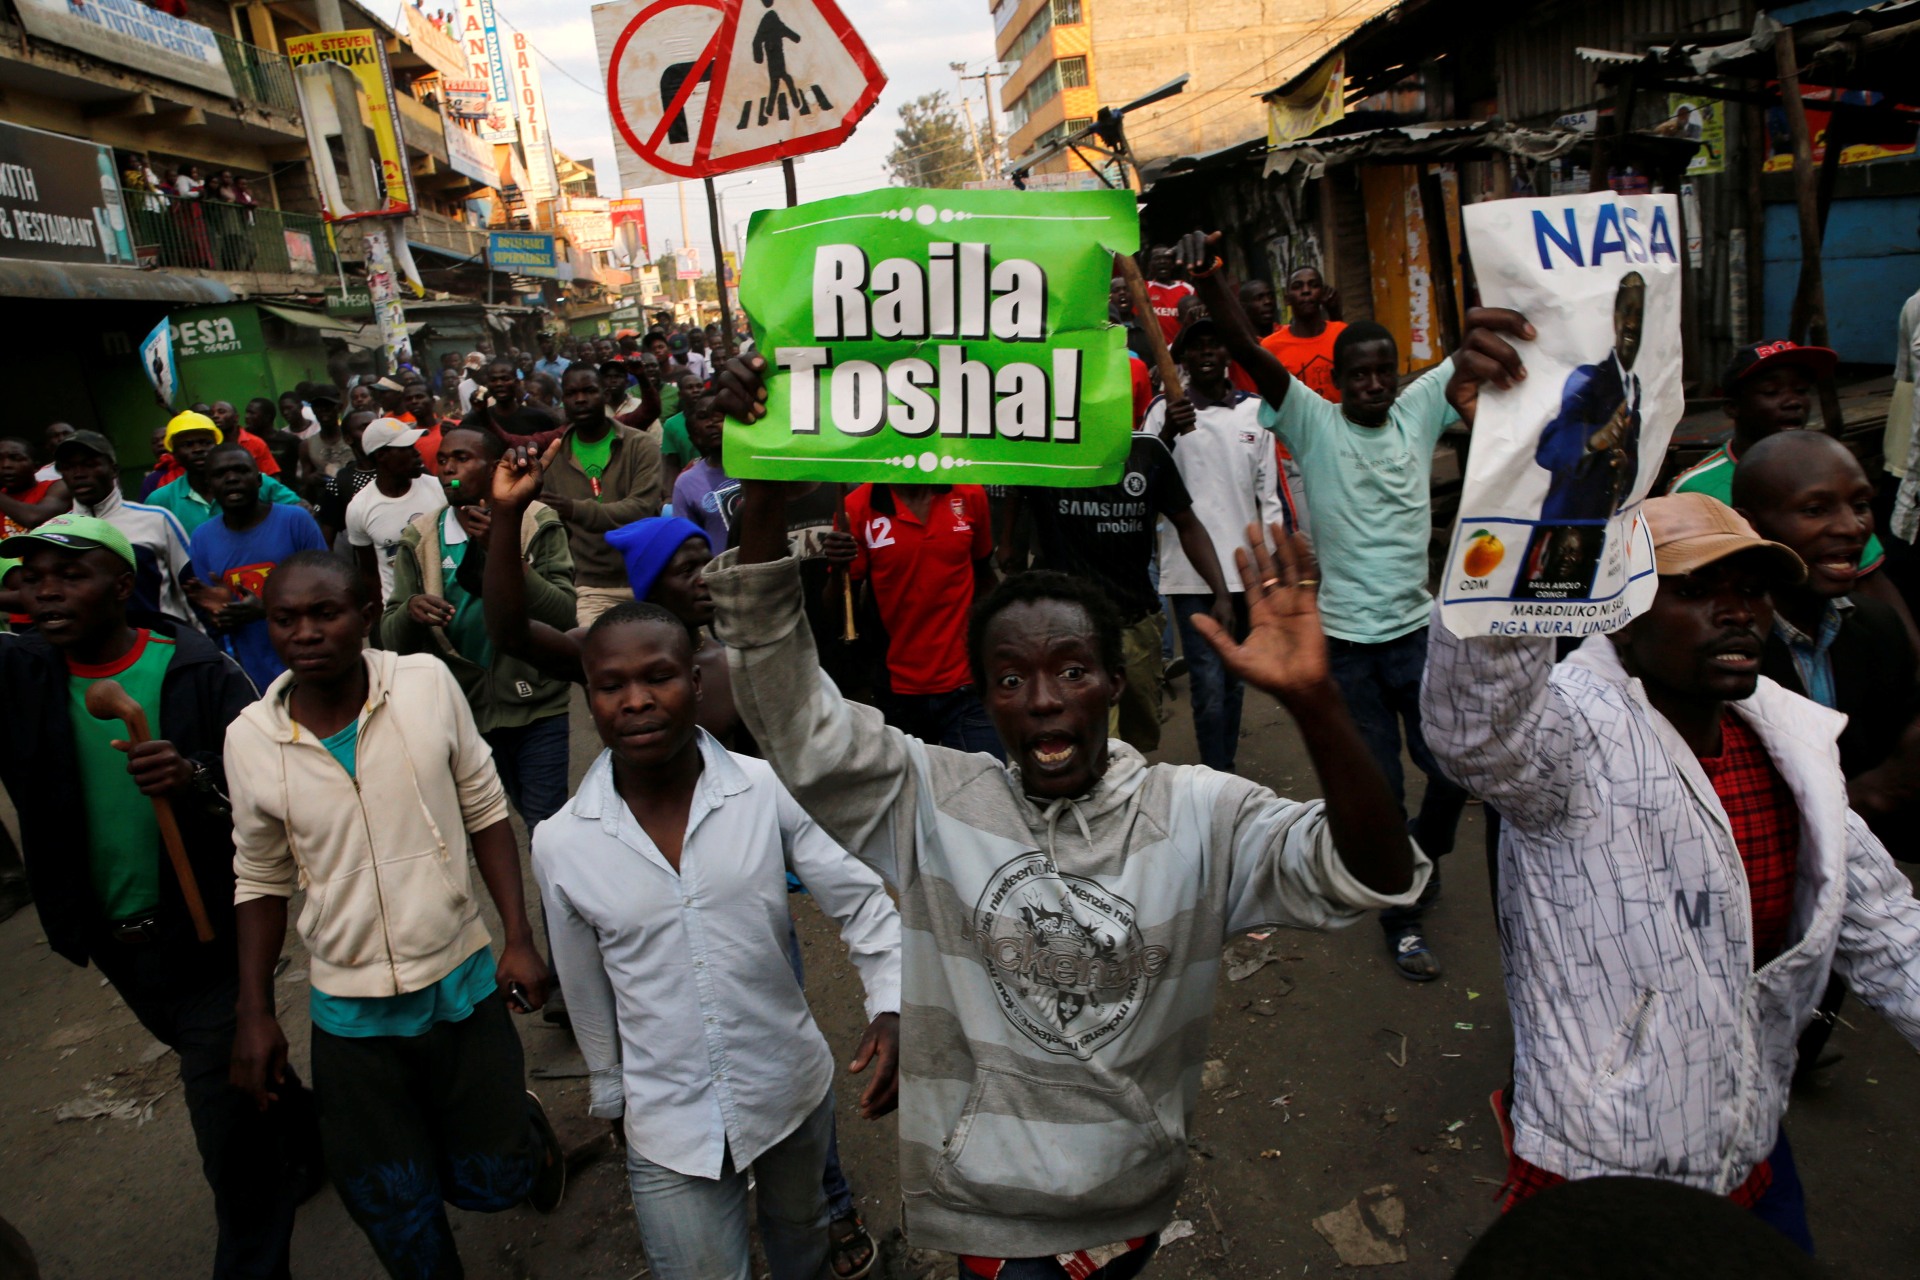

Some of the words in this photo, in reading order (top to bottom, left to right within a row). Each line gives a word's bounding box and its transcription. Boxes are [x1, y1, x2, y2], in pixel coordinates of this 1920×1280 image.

[289, 42, 318, 55] HON.
[321, 36, 371, 50] STEVEN
[513, 32, 539, 143] BALOZI
[12, 209, 97, 247] RESTAURANT
[1531, 203, 1678, 270] NASA
[812, 242, 1047, 342] Raila
[775, 344, 1083, 444] Tosha!
[1059, 499, 1146, 517] SAMSUNG
[865, 516, 896, 549] 12
[1096, 519, 1143, 533] mobile
[1459, 580, 1489, 591] ODM
[1511, 604, 1597, 617] MABADILIKO
[1489, 620, 1528, 635] PIGA
[1534, 621, 1573, 634] KURA
[1582, 618, 1616, 635] LINDA
